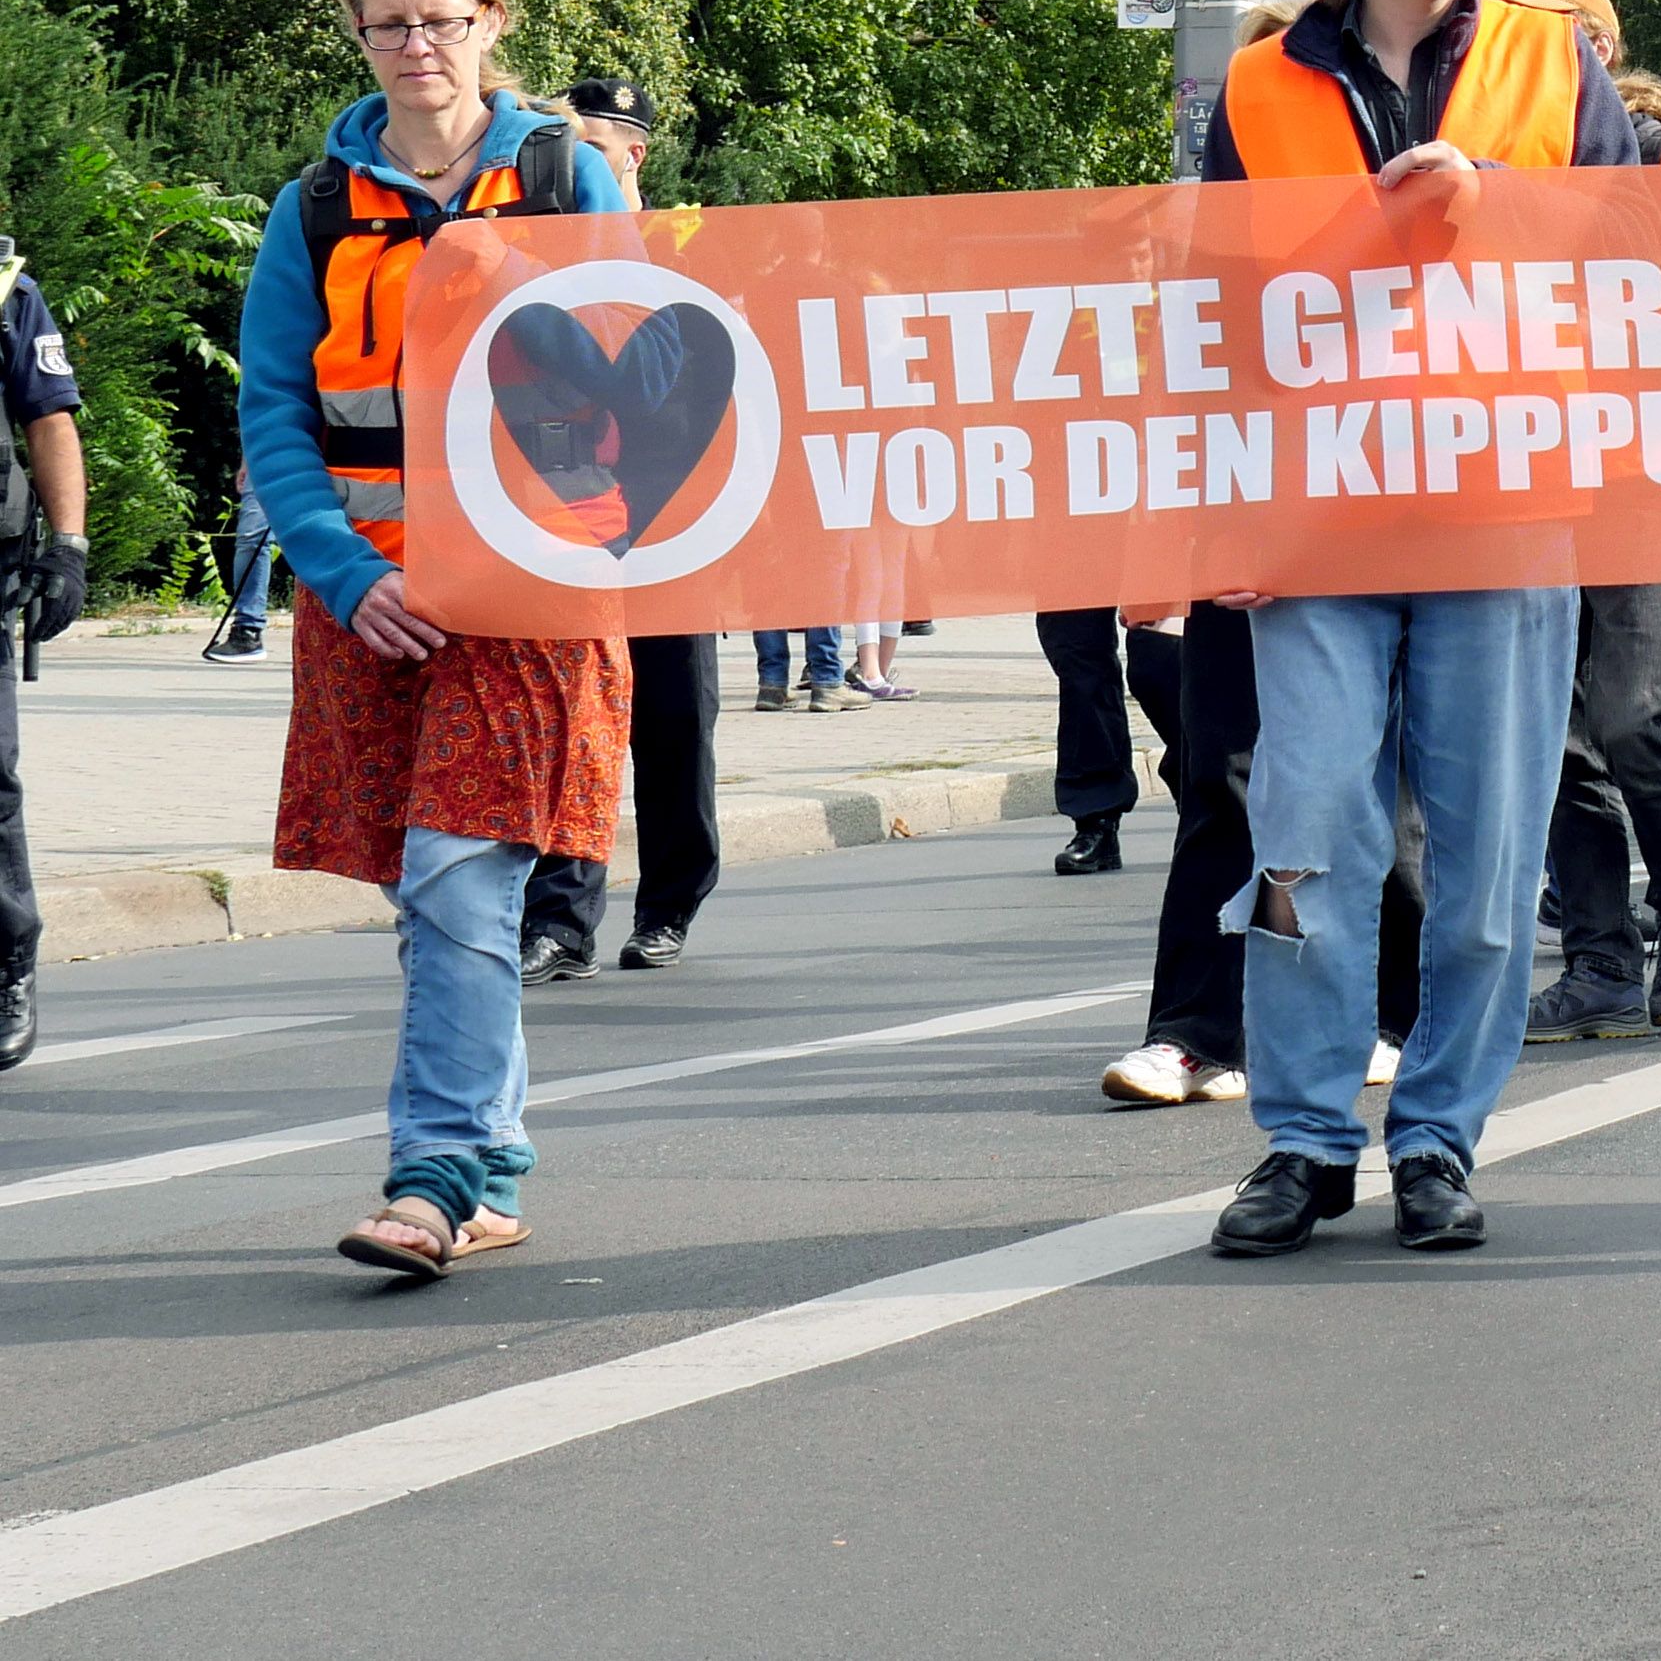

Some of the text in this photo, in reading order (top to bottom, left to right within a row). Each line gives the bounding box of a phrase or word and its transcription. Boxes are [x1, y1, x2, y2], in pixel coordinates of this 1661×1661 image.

[798, 279, 1229, 412] LETZTE
[801, 425, 1034, 531] VOR
[1065, 410, 1273, 517] DEN
